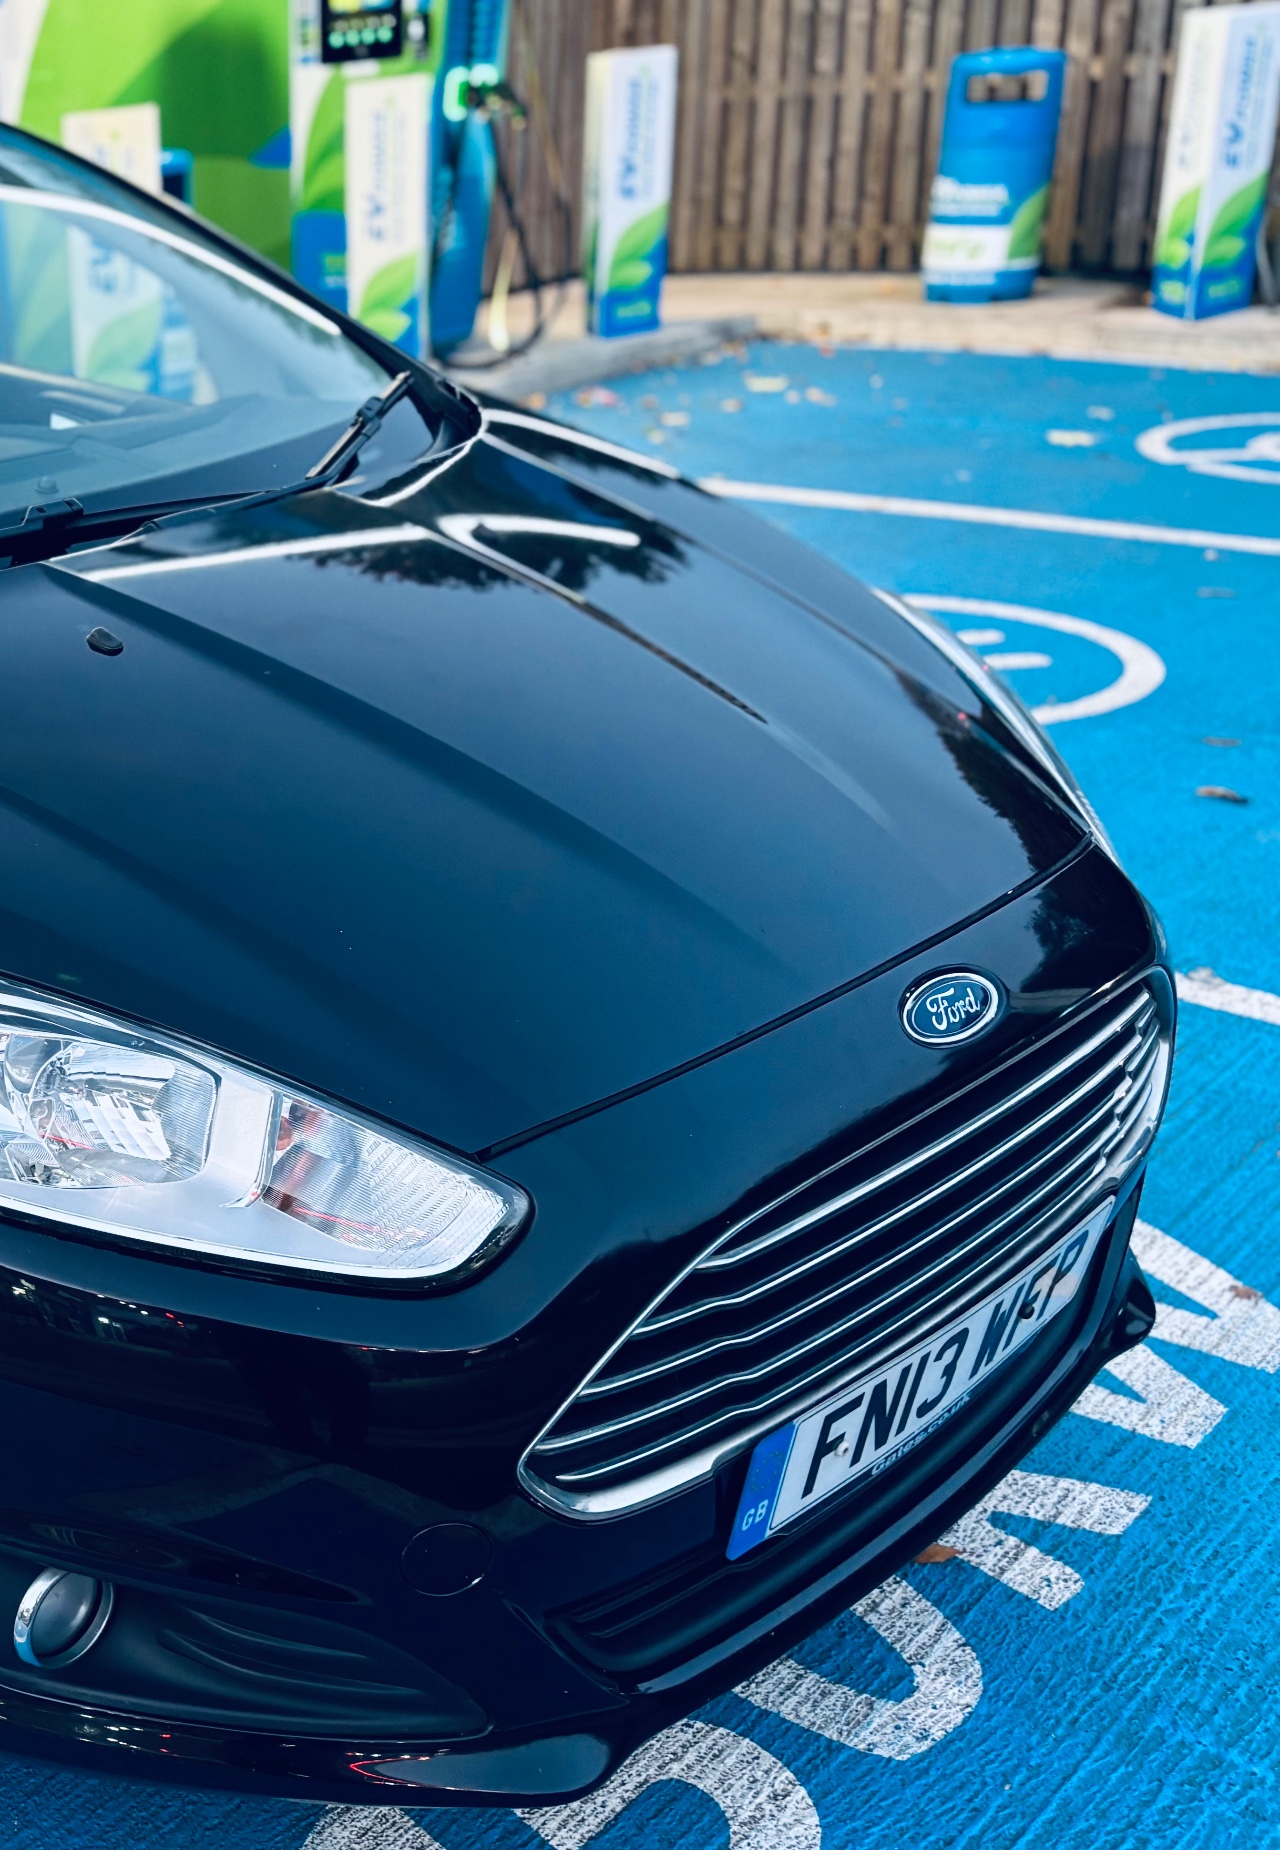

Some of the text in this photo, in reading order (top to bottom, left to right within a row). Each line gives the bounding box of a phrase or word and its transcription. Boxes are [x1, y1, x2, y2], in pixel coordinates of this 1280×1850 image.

[926, 987, 980, 1031] Ford
[801, 1327, 969, 1501] FN13
[741, 1498, 769, 1532] GB
